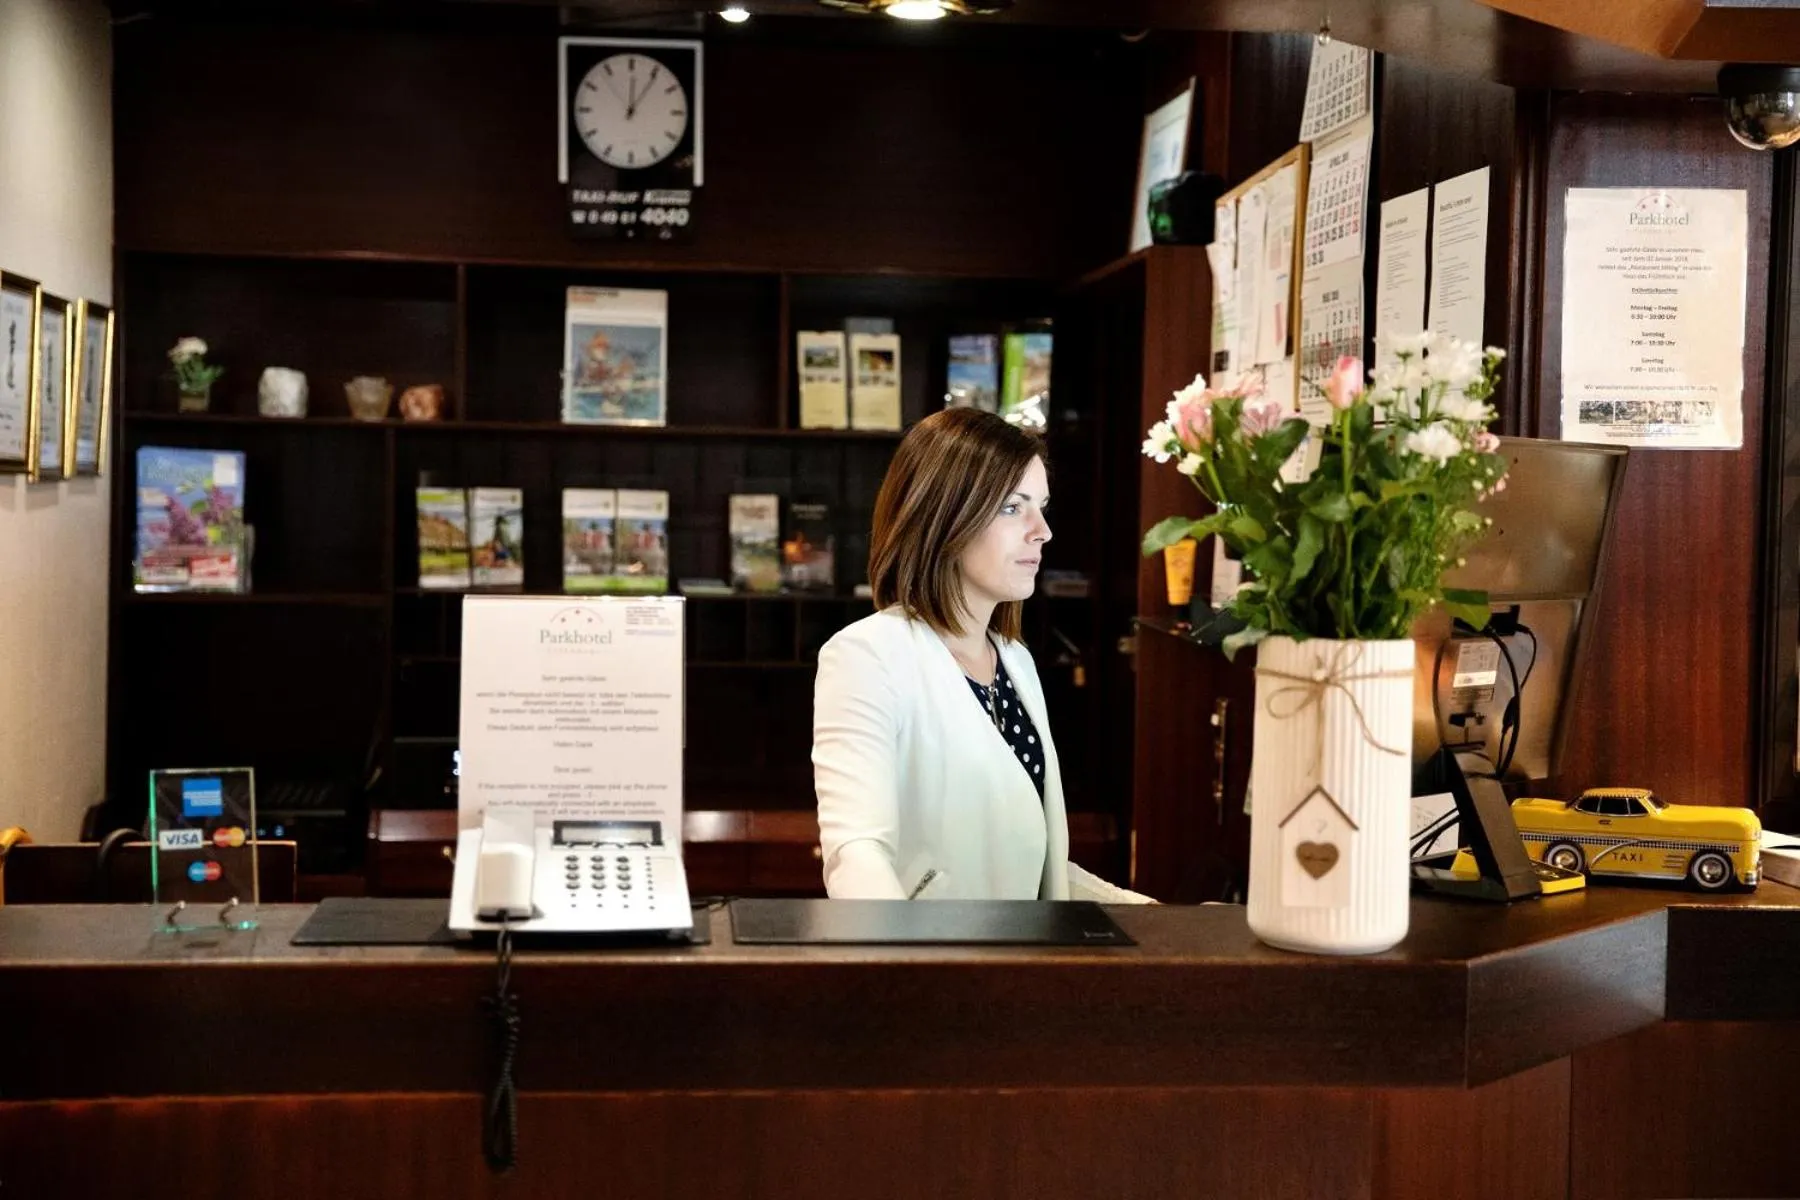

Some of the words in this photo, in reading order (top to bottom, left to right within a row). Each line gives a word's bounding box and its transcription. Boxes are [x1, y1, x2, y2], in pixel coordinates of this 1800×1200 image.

[640, 208, 690, 226] 4040
[1629, 212, 1690, 226] Parkhotel
[540, 629, 612, 644] Parkhotel
[166, 834, 198, 845] VISA
[1612, 852, 1643, 861] TAXI
